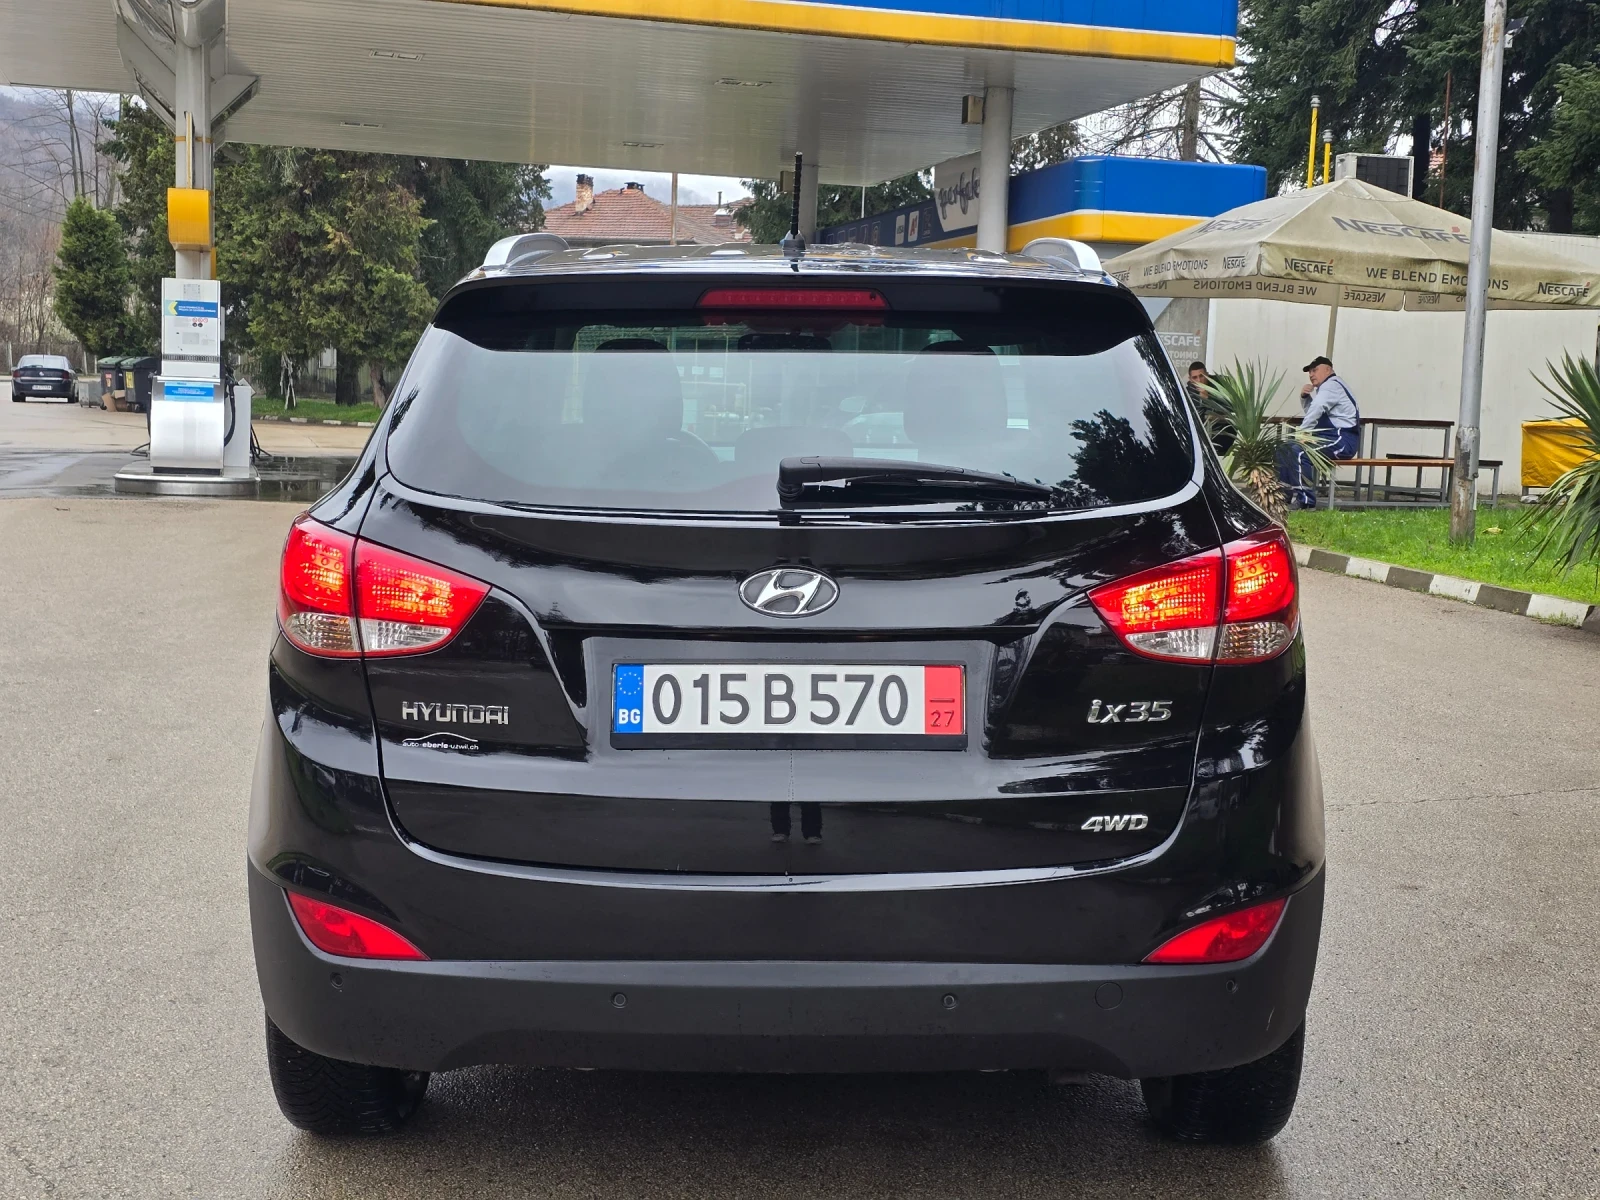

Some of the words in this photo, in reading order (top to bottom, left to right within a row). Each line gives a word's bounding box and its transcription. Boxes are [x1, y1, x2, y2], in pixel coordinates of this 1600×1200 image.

[1143, 266, 1153, 277] WE
[1173, 259, 1209, 272] EMOTIONS
[1284, 258, 1335, 276] NESCAFÉ
[1366, 267, 1388, 280] WE
[1392, 269, 1438, 284] BLEND
[1537, 281, 1591, 298] NESCAFÉ
[401, 701, 509, 725] HYUNDAI
[618, 708, 641, 724] BG
[930, 709, 955, 728] 27
[1087, 699, 1173, 723] ix35
[1081, 814, 1149, 832] 4WD
